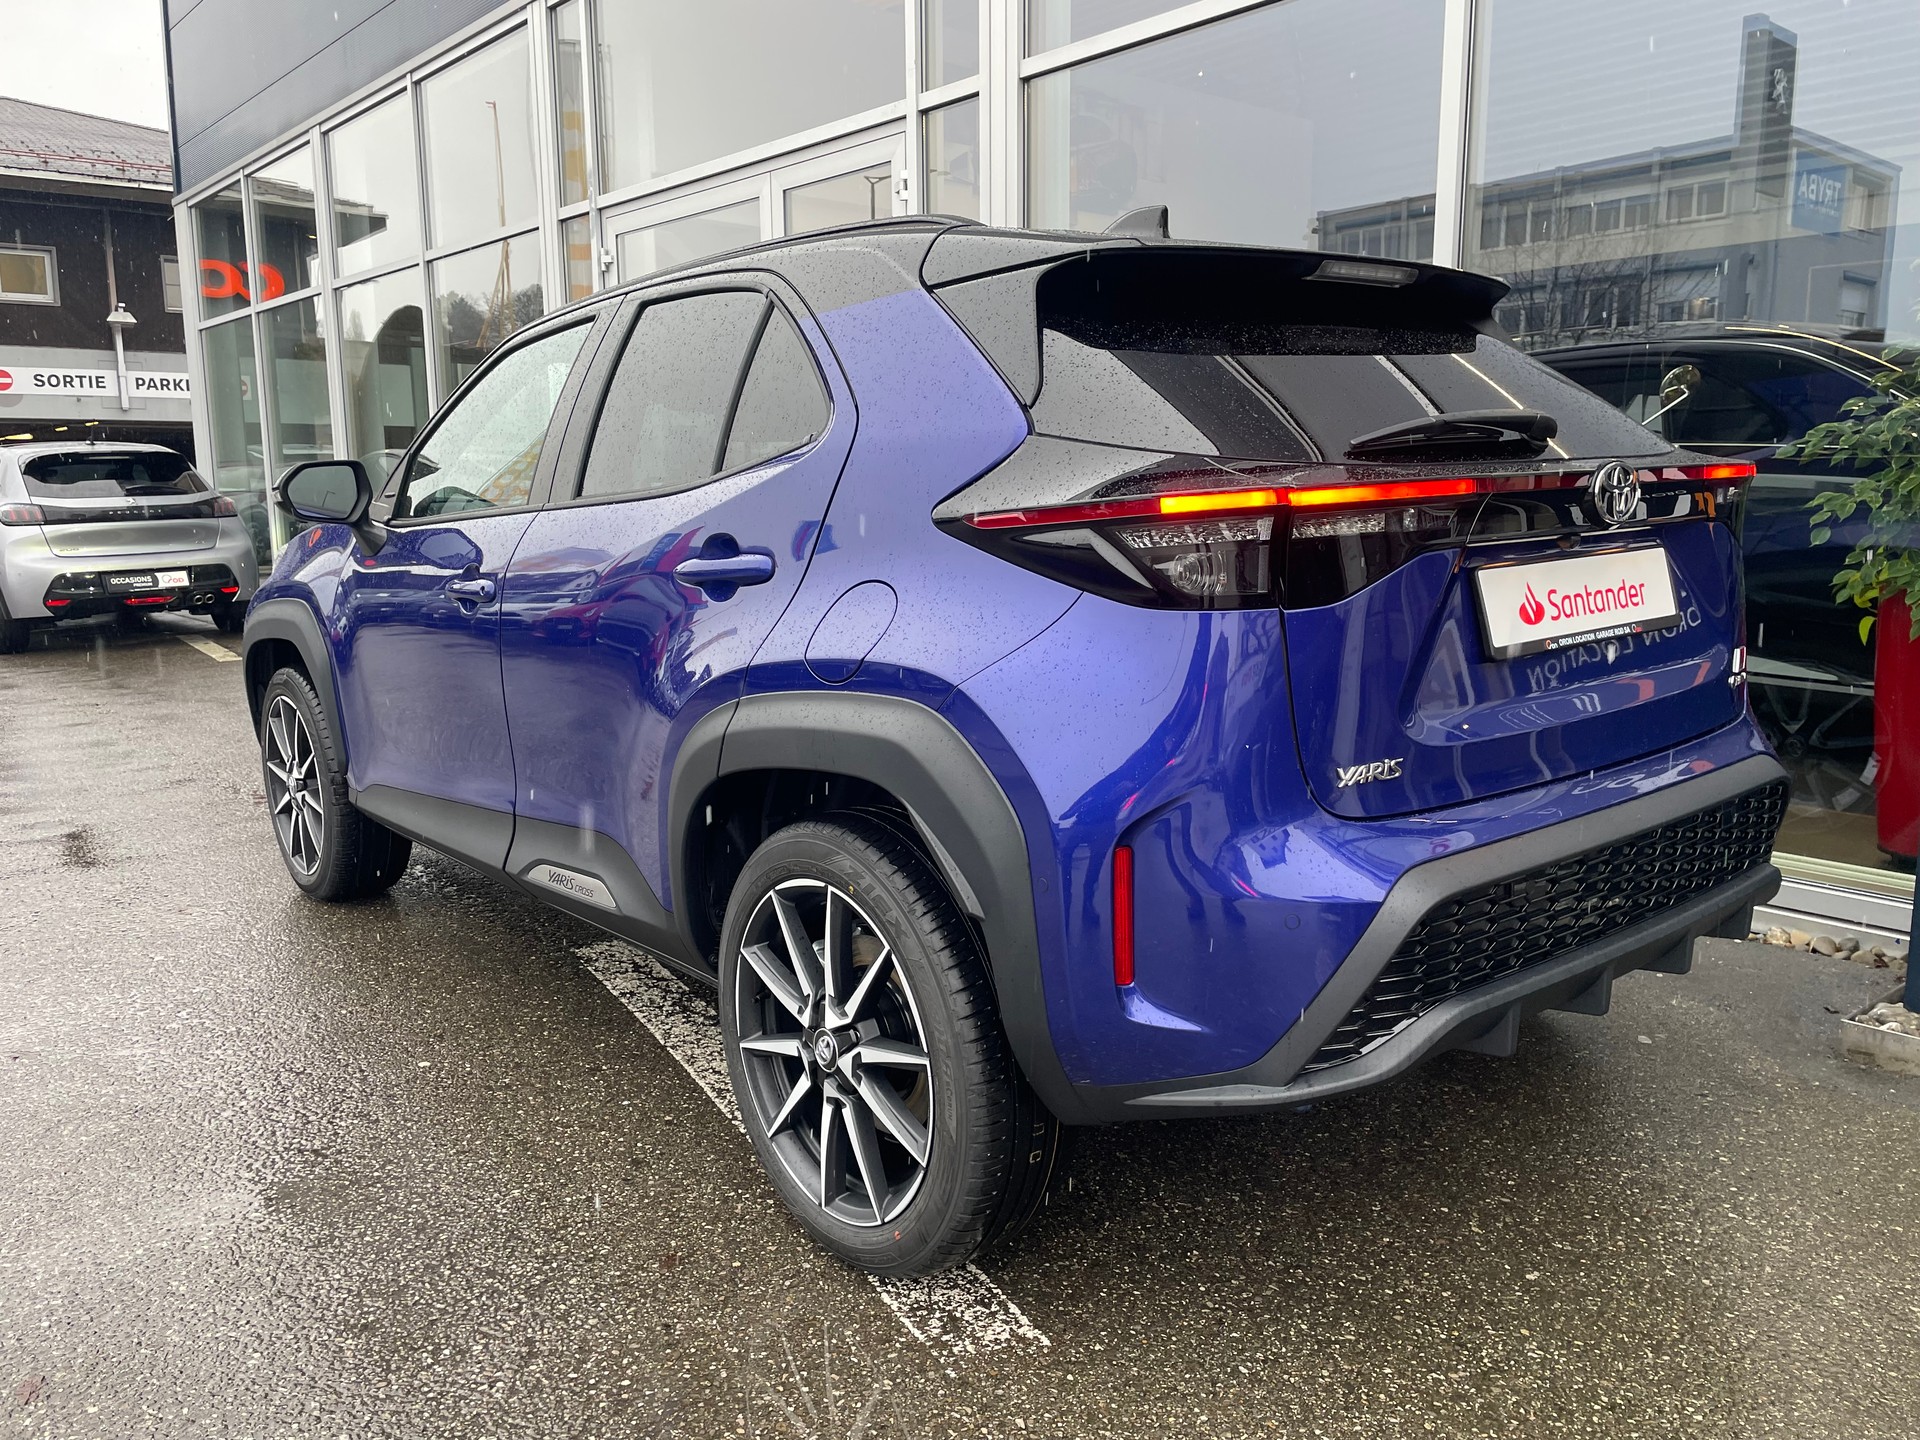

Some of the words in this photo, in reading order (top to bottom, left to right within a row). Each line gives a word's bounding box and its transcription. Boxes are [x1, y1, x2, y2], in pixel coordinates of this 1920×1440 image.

[33, 373, 107, 389] SORTIE
[110, 576, 152, 584] OCCASIONS
[1547, 579, 1645, 621] Santander
[1573, 632, 1595, 644] LOCATION
[1596, 628, 1614, 639] GARAGE
[1336, 758, 1404, 788] YARIS
[548, 870, 575, 890] YARIS
[574, 884, 594, 898] CROSS
